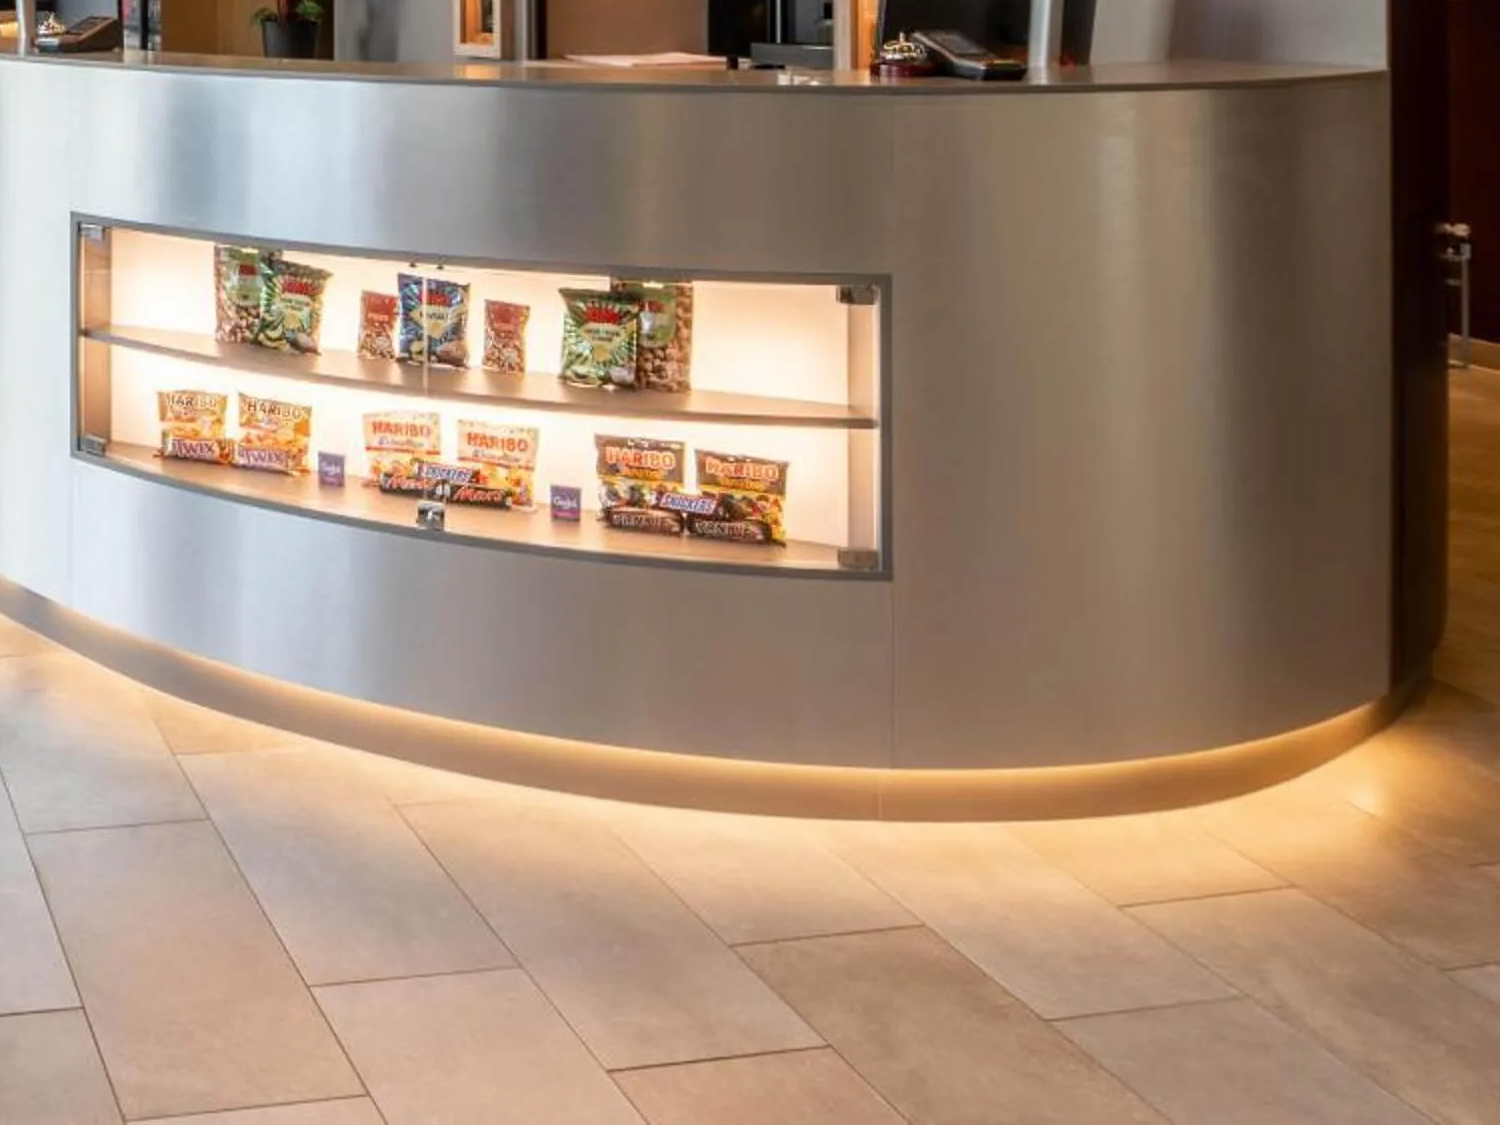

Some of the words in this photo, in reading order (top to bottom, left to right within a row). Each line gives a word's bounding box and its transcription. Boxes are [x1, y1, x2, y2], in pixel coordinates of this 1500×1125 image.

[247, 401, 302, 419] HARIBO
[371, 420, 432, 437] HARIBO
[467, 432, 529, 453] HARIBO
[604, 446, 676, 471] HARIBO
[704, 456, 779, 480] HARIBO
